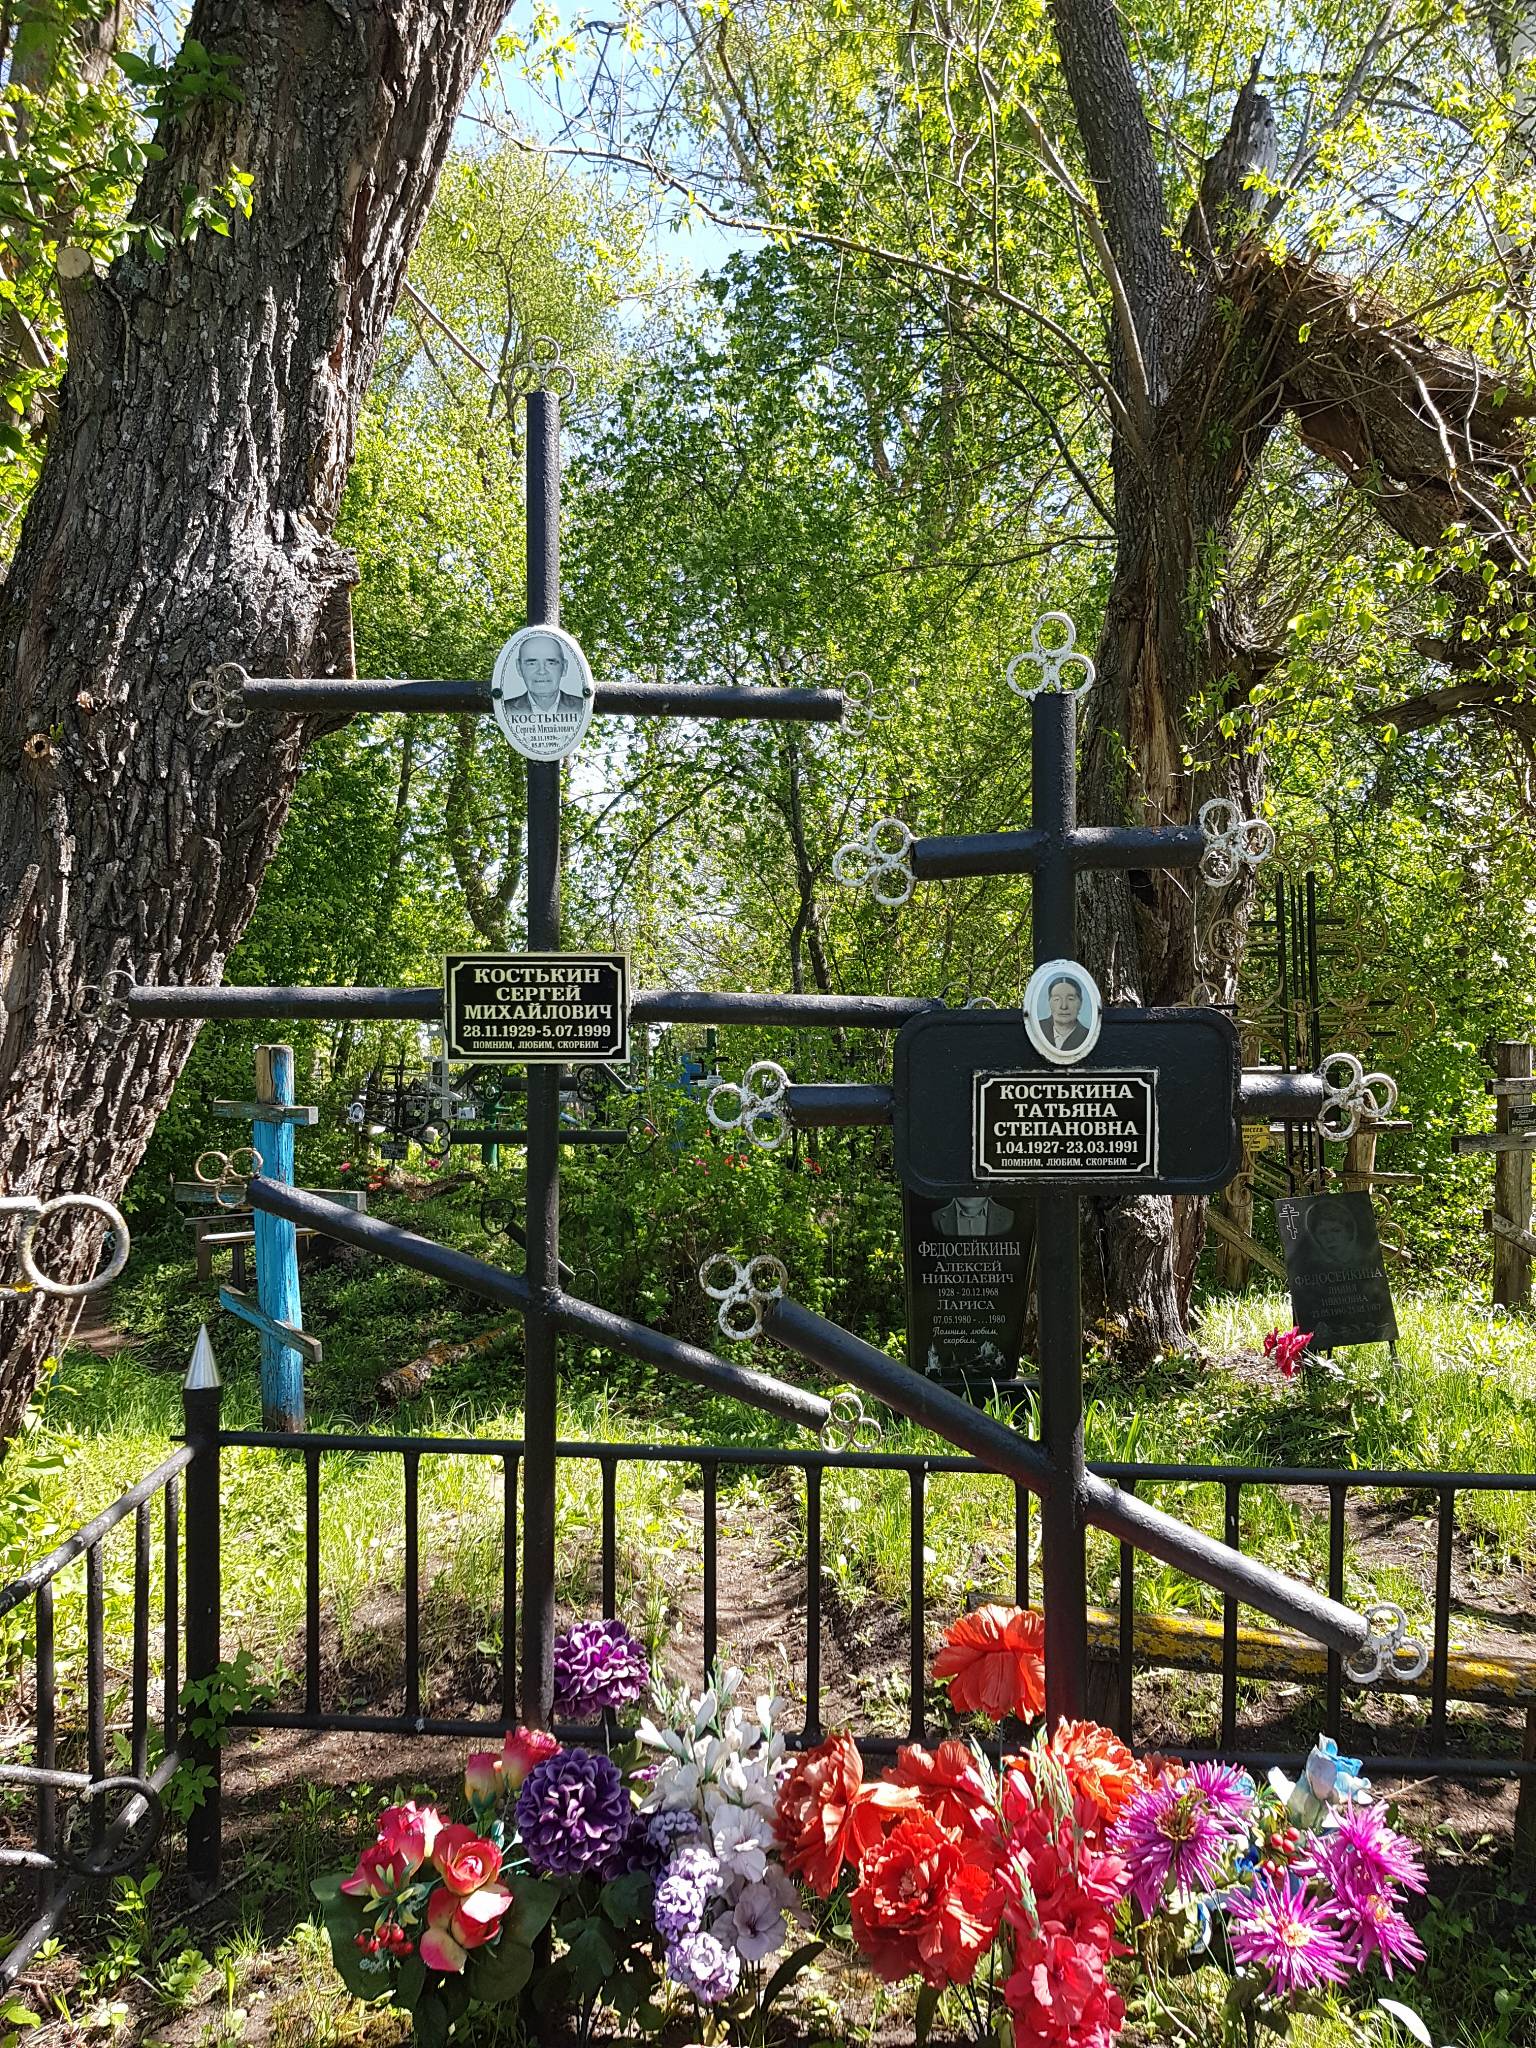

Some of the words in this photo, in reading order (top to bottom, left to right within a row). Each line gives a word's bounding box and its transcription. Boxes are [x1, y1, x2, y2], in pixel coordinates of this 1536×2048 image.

[511, 713, 578, 724] КОСТЬКИН
[515, 724, 536, 735] Сергей
[537, 724, 575, 733] Михайлович
[474, 968, 600, 983] КОСТЬКИН
[496, 985, 582, 1001] СЕРГЕЙ
[464, 1003, 613, 1020] МИХАЙЛОВИЧ
[463, 1025, 611, 1037] 28.11.1929-5.07.1999
[473, 1041, 515, 1050] ПОМНИМ,
[518, 1041, 555, 1050] ЛЮБИМ,
[999, 1084, 1134, 1100] КОСТЬКИНА
[1014, 1103, 1119, 1118] ТАТЬЯНА
[993, 1121, 1139, 1137] СТЕПАНОВНА
[1001, 1158, 1044, 1167] ПОМНИМ,
[1046, 1157, 1083, 1167] ЛЮБИМ,
[918, 1240, 1020, 1258] ФЕДОСЕЙКИНЫ
[935, 1260, 1002, 1272] АЛЕКСЕЙ
[922, 1273, 1014, 1284] НИКОЛАЕВИЧ
[1294, 1267, 1383, 1287] ФЕДОСЕЙКИНА
[937, 1299, 996, 1310] ЛАРИСА
